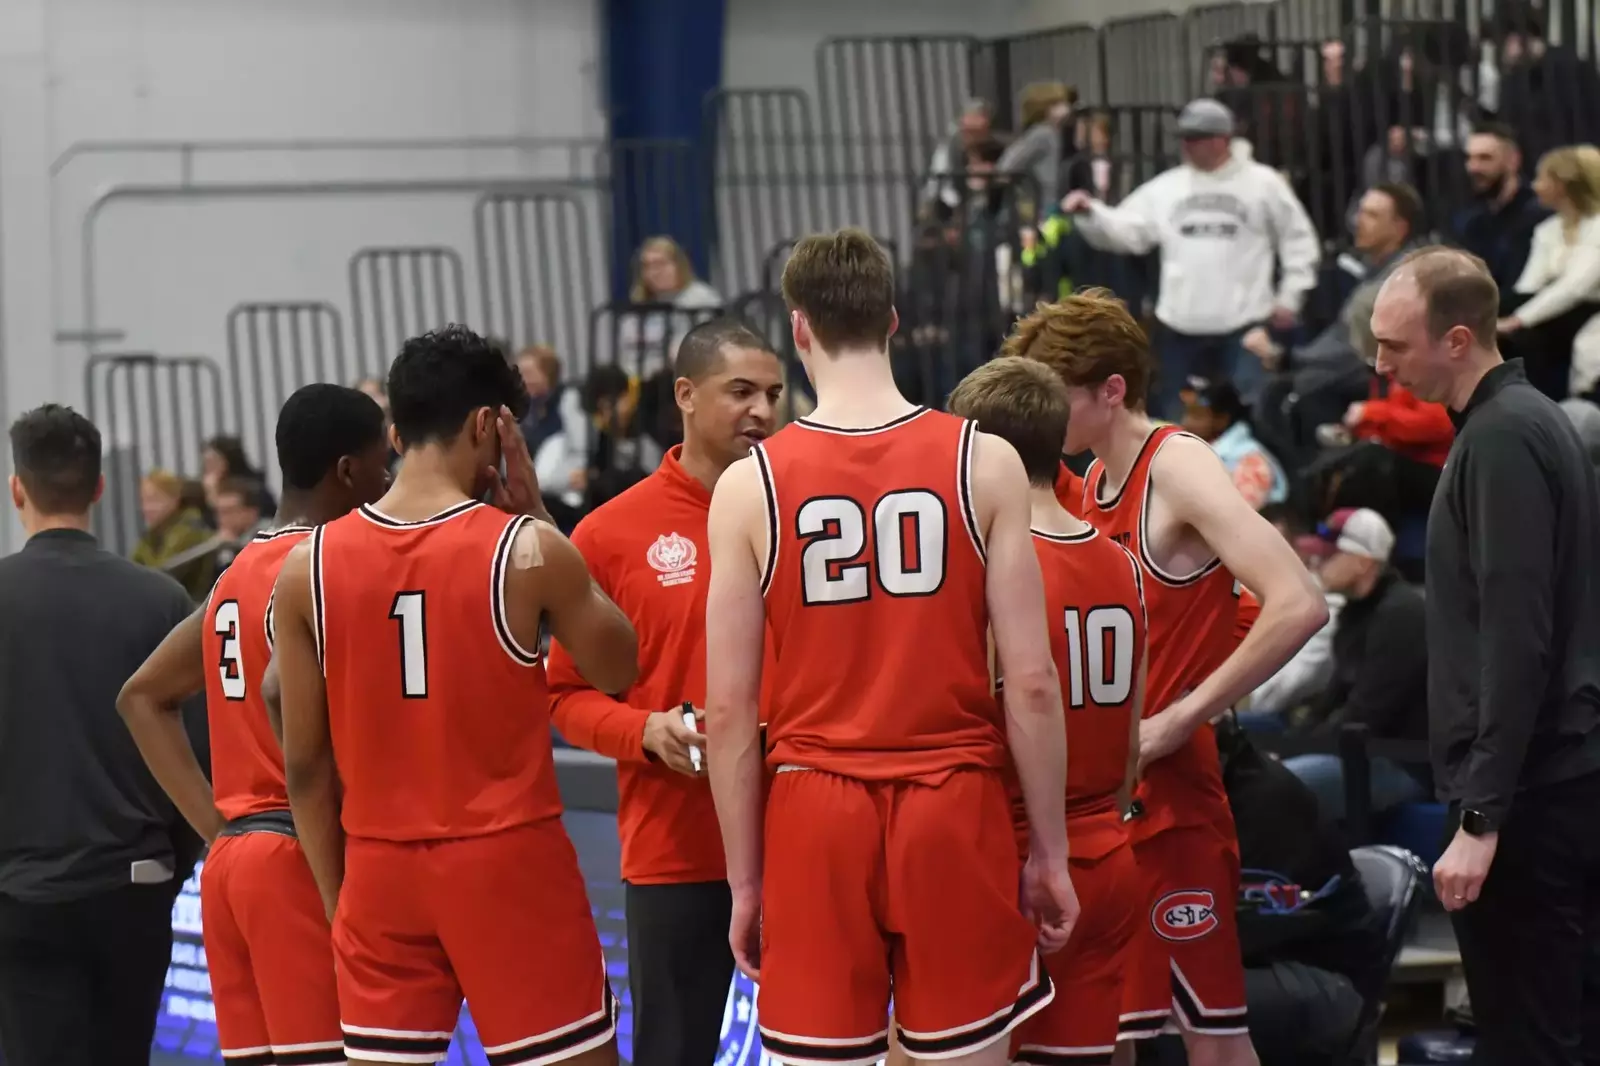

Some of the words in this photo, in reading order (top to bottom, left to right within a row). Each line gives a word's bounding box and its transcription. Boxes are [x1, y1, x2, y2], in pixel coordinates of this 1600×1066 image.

[795, 487, 948, 607] 20
[215, 599, 246, 701] 3
[388, 590, 428, 699] 1
[1064, 604, 1135, 710] 10
